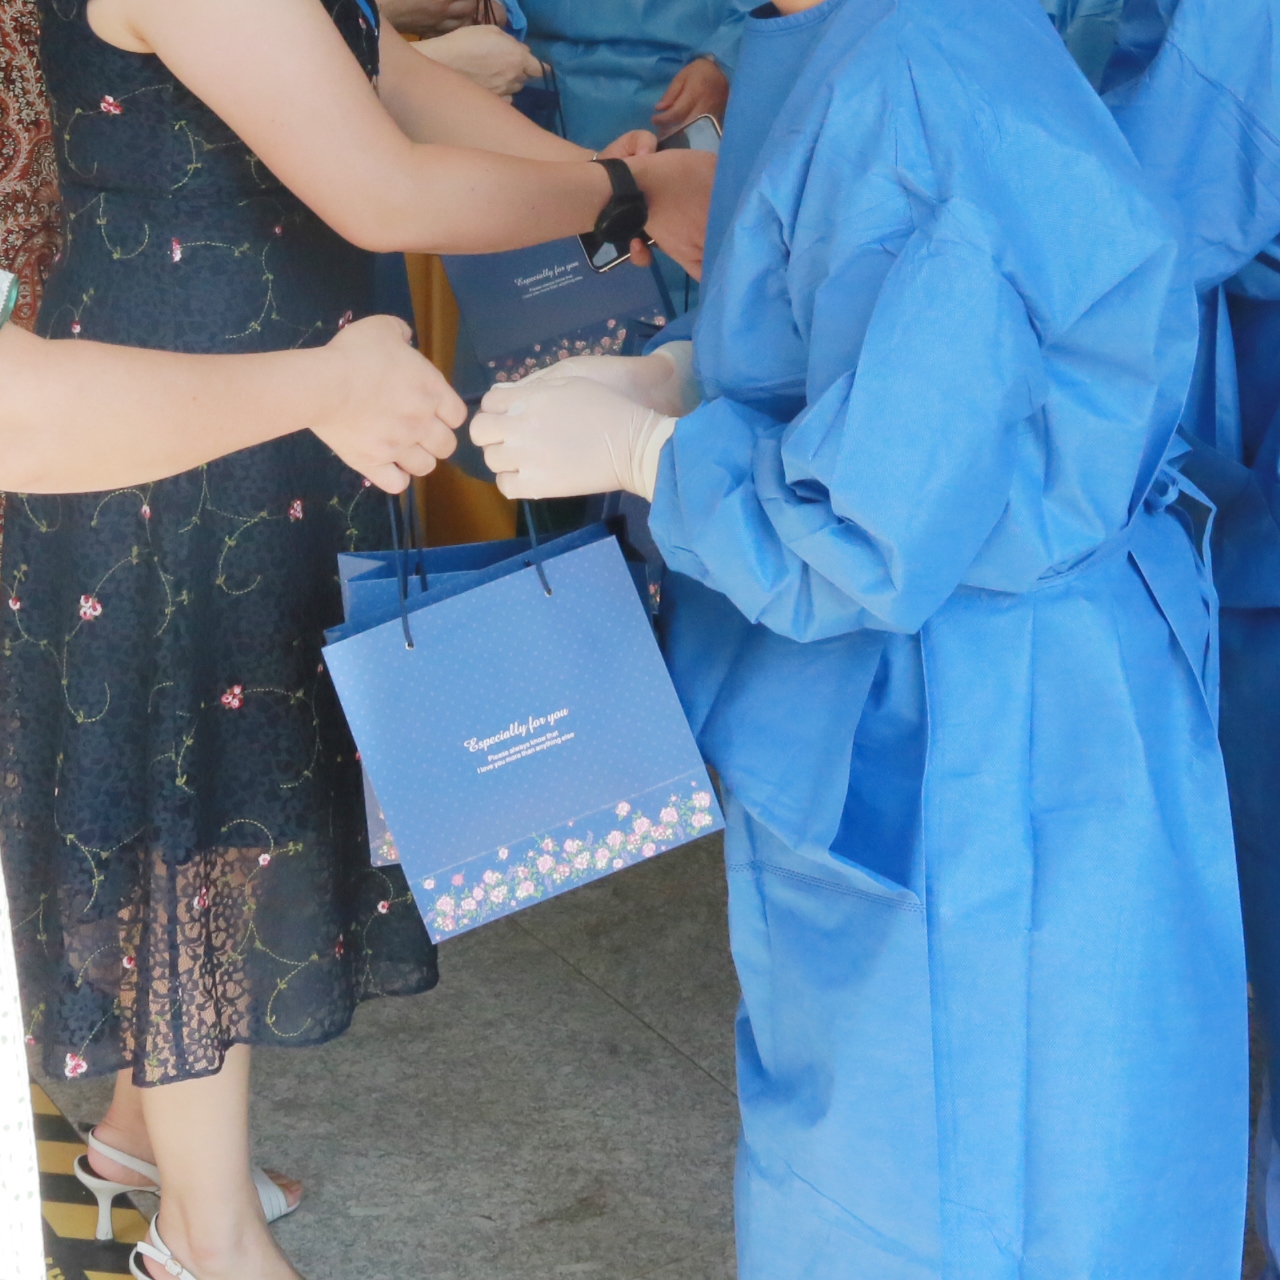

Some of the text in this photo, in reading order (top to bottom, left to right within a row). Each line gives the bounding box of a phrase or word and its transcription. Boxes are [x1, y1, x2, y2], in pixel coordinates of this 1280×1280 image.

[514, 268, 554, 286] Especially
[554, 265, 565, 276] for
[566, 261, 579, 271] you
[463, 708, 569, 753] Especially for you
[487, 730, 559, 762] Please always know that
[480, 763, 494, 773] love
[494, 760, 506, 769] you
[506, 753, 522, 763] more
[521, 748, 535, 758] than
[535, 737, 562, 752] anything
[561, 732, 575, 741] else
